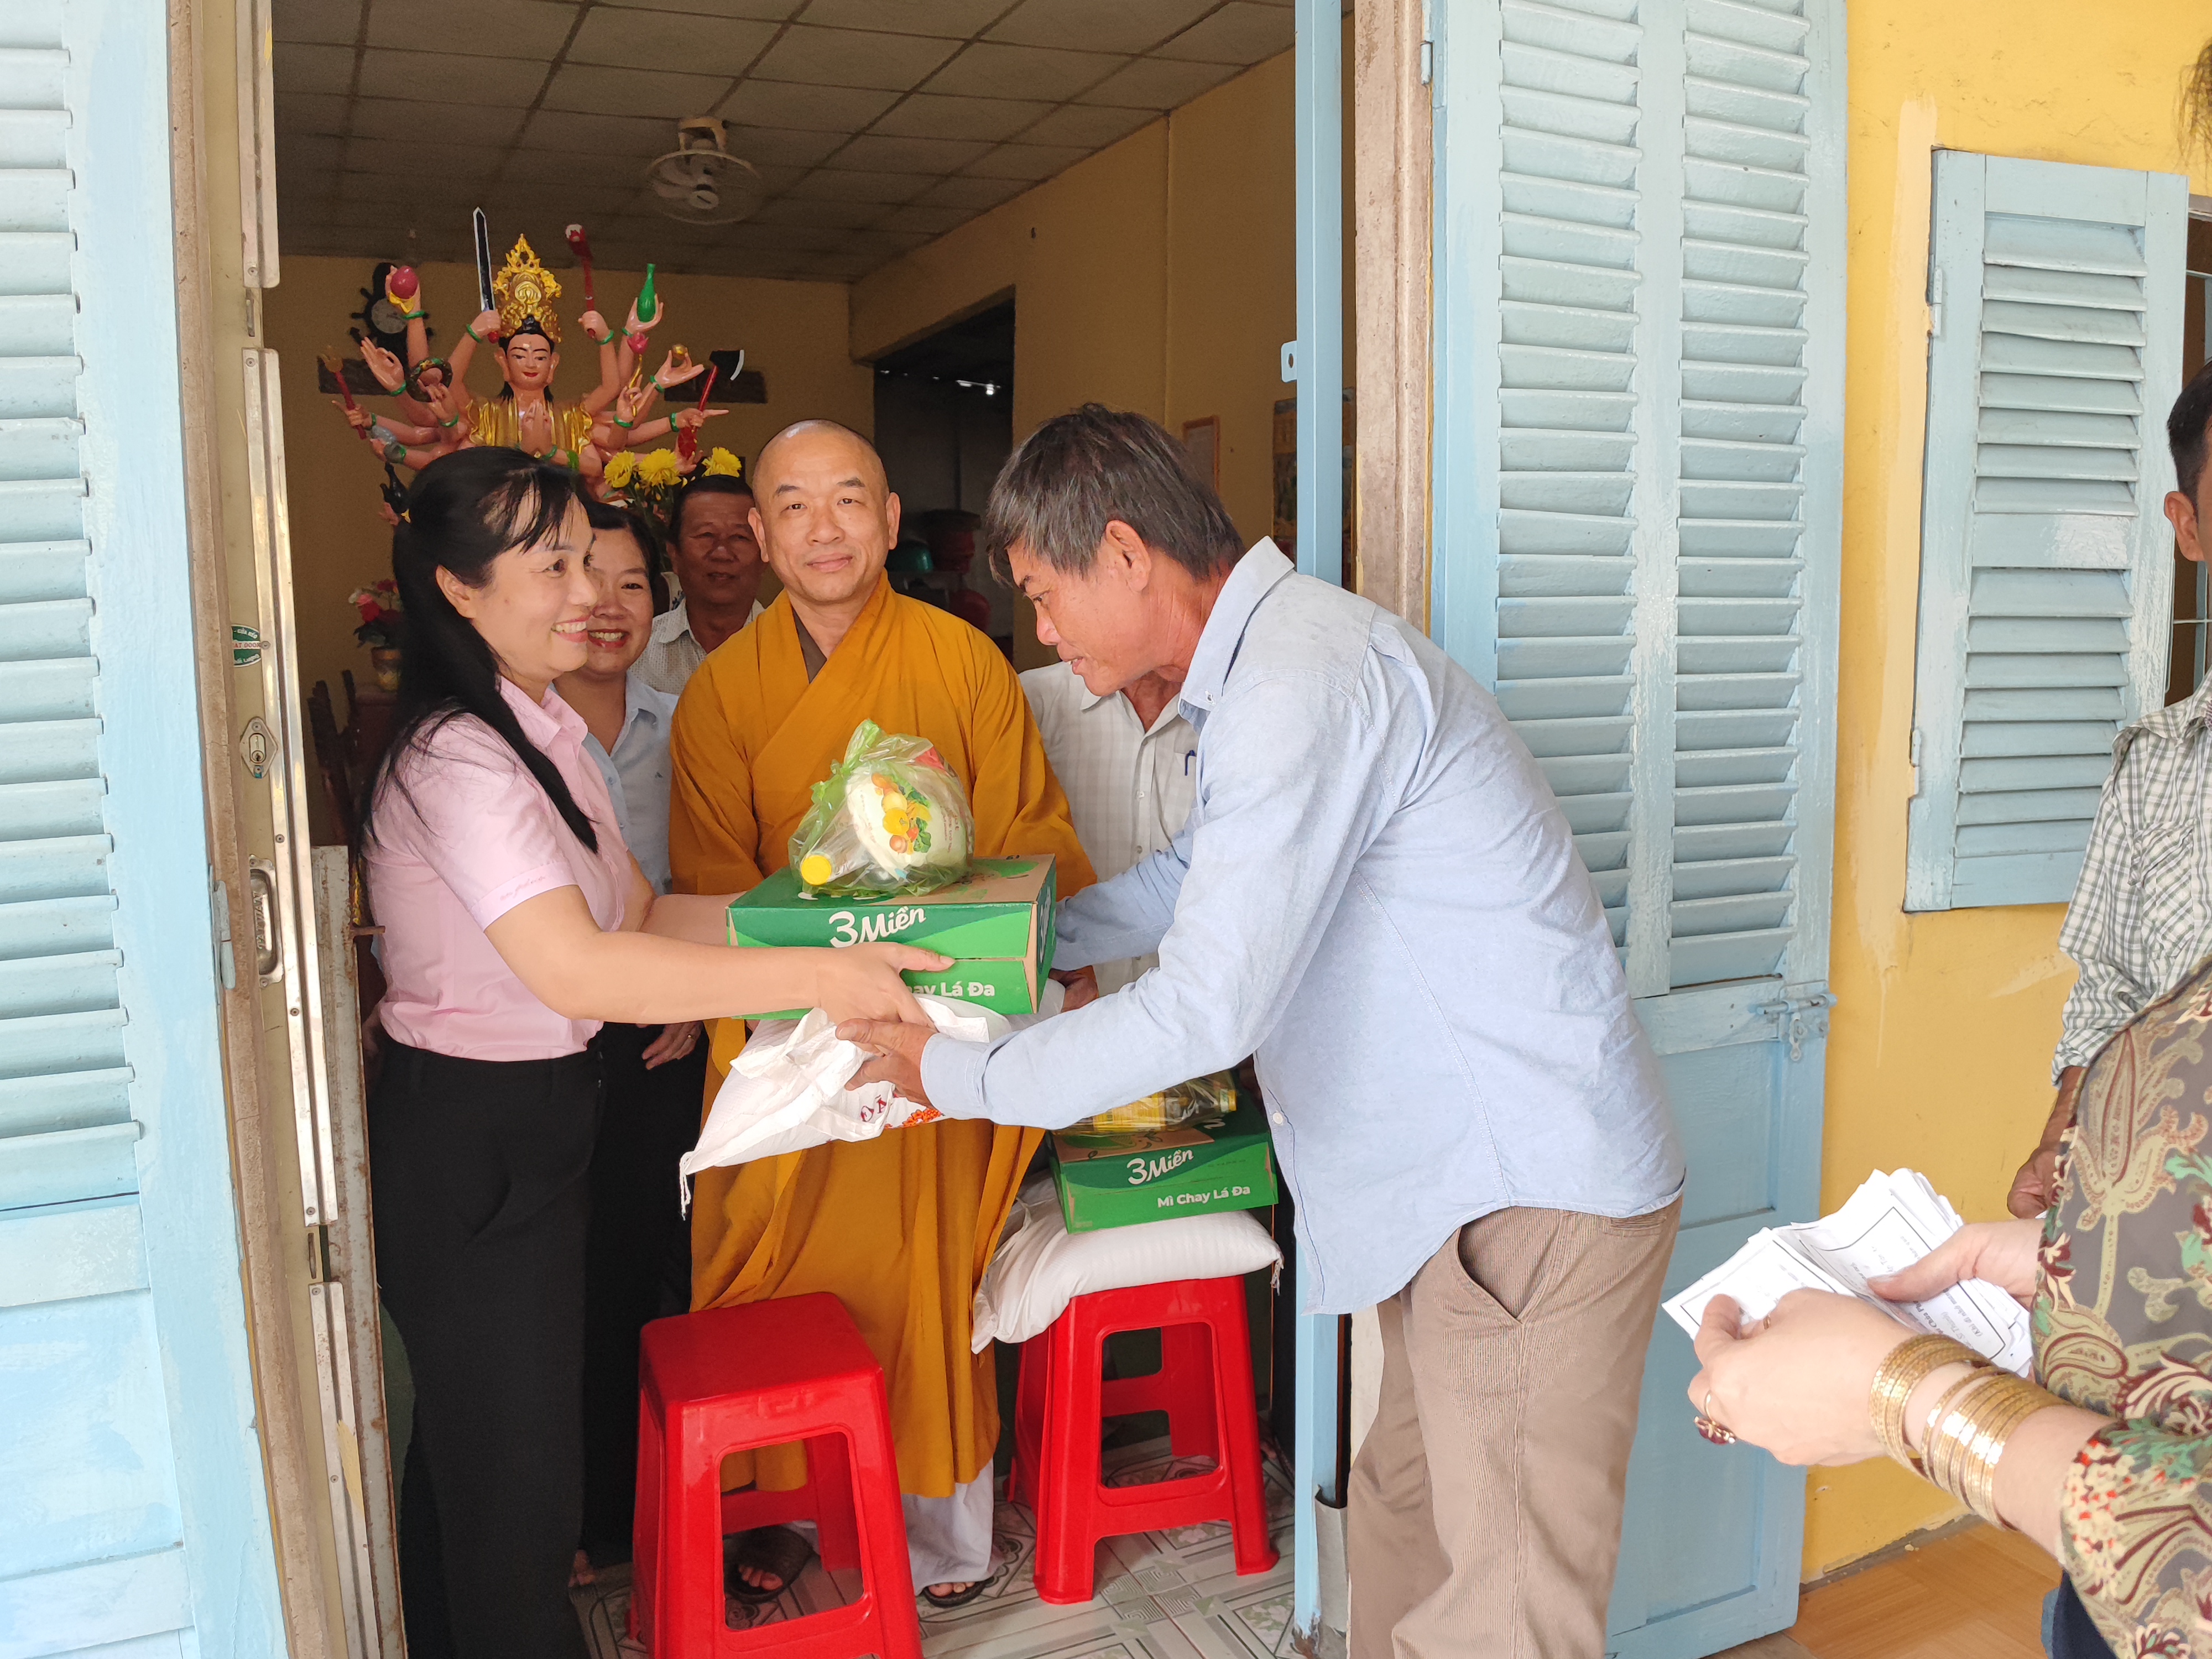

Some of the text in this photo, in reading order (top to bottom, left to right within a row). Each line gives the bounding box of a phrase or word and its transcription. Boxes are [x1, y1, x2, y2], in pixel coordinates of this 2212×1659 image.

[253, 891, 267, 950] TAIWAN
[940, 980, 963, 997] Lá
[966, 982, 995, 997] Đa
[1157, 1186, 1251, 1208] Mì Chay Lá Đa
